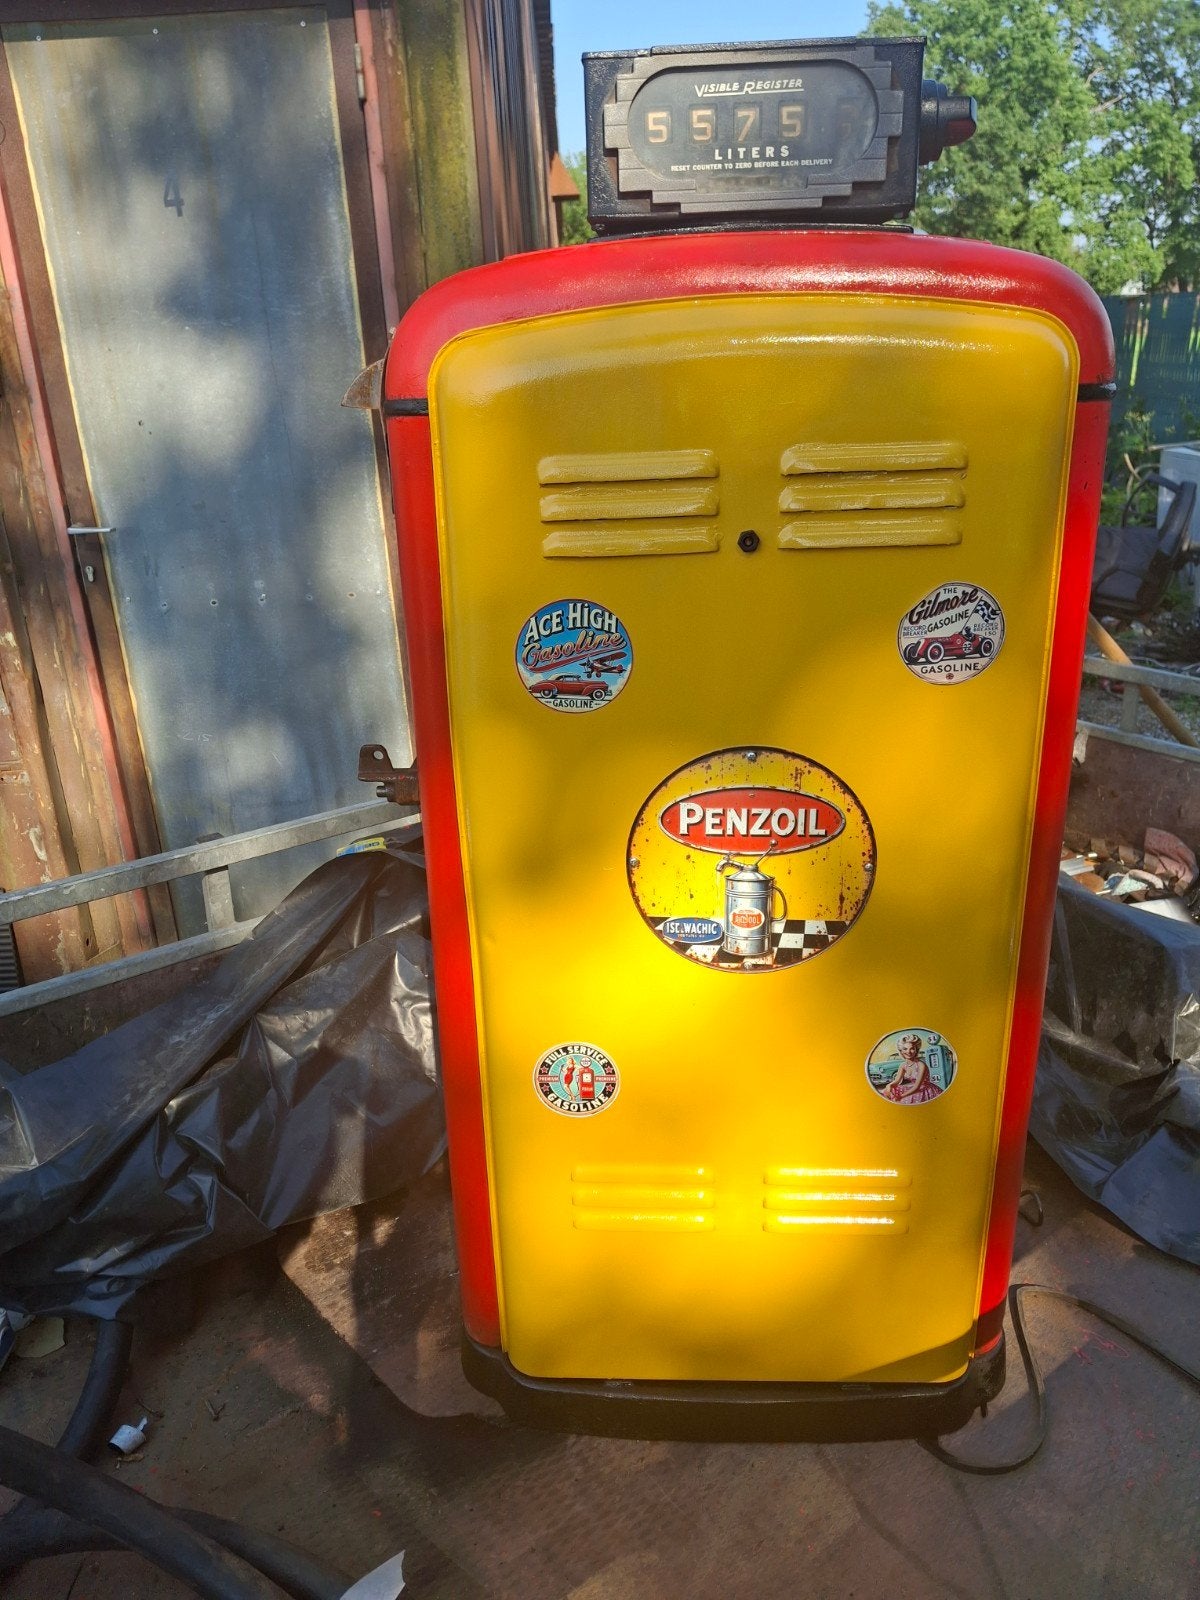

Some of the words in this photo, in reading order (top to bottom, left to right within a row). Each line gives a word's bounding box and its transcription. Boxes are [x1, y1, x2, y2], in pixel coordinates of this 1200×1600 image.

[694, 82, 740, 98] VISIBLE
[743, 78, 803, 95] REGISTER
[714, 145, 790, 161] LITERS
[692, 163, 722, 171] COUNTER
[754, 160, 779, 168] BEFORE
[781, 159, 799, 167] EACH
[801, 158, 833, 166] DELIVERY
[908, 588, 979, 625] Gilmore
[523, 610, 563, 646] ACE
[927, 609, 970, 633] GASOLINE
[522, 629, 624, 668] Gasoline
[920, 662, 980, 674] GASOLINE
[552, 699, 594, 709] GASOLINE
[679, 802, 828, 837] PENZOIL
[545, 1049, 567, 1065] FULL
[567, 1045, 608, 1065] SERVICE
[547, 1093, 609, 1112] GASOLINE
